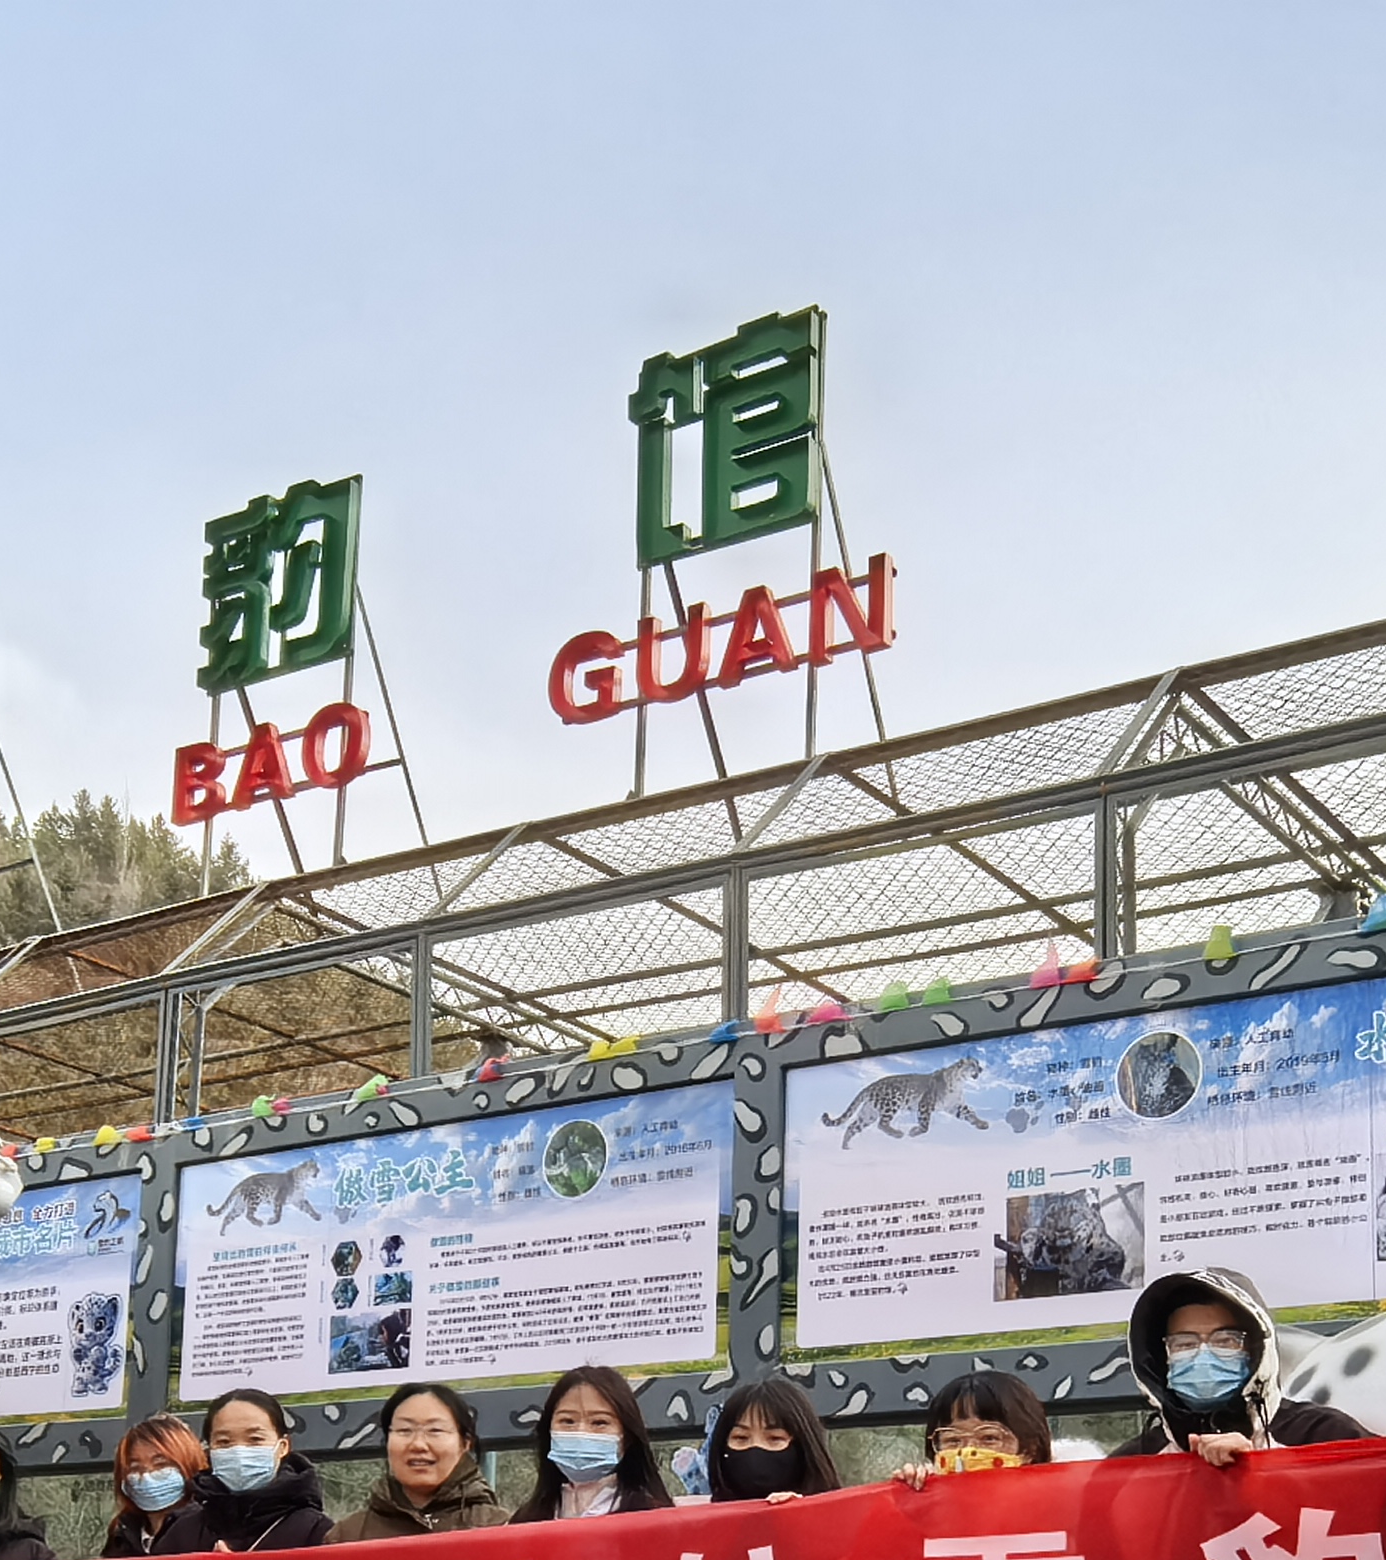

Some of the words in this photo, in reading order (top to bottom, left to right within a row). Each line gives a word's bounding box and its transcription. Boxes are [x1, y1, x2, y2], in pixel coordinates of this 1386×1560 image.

[171, 702, 370, 826] BAO
[548, 552, 897, 724] GUAN
[334, 1148, 475, 1206] 傲雪公主
